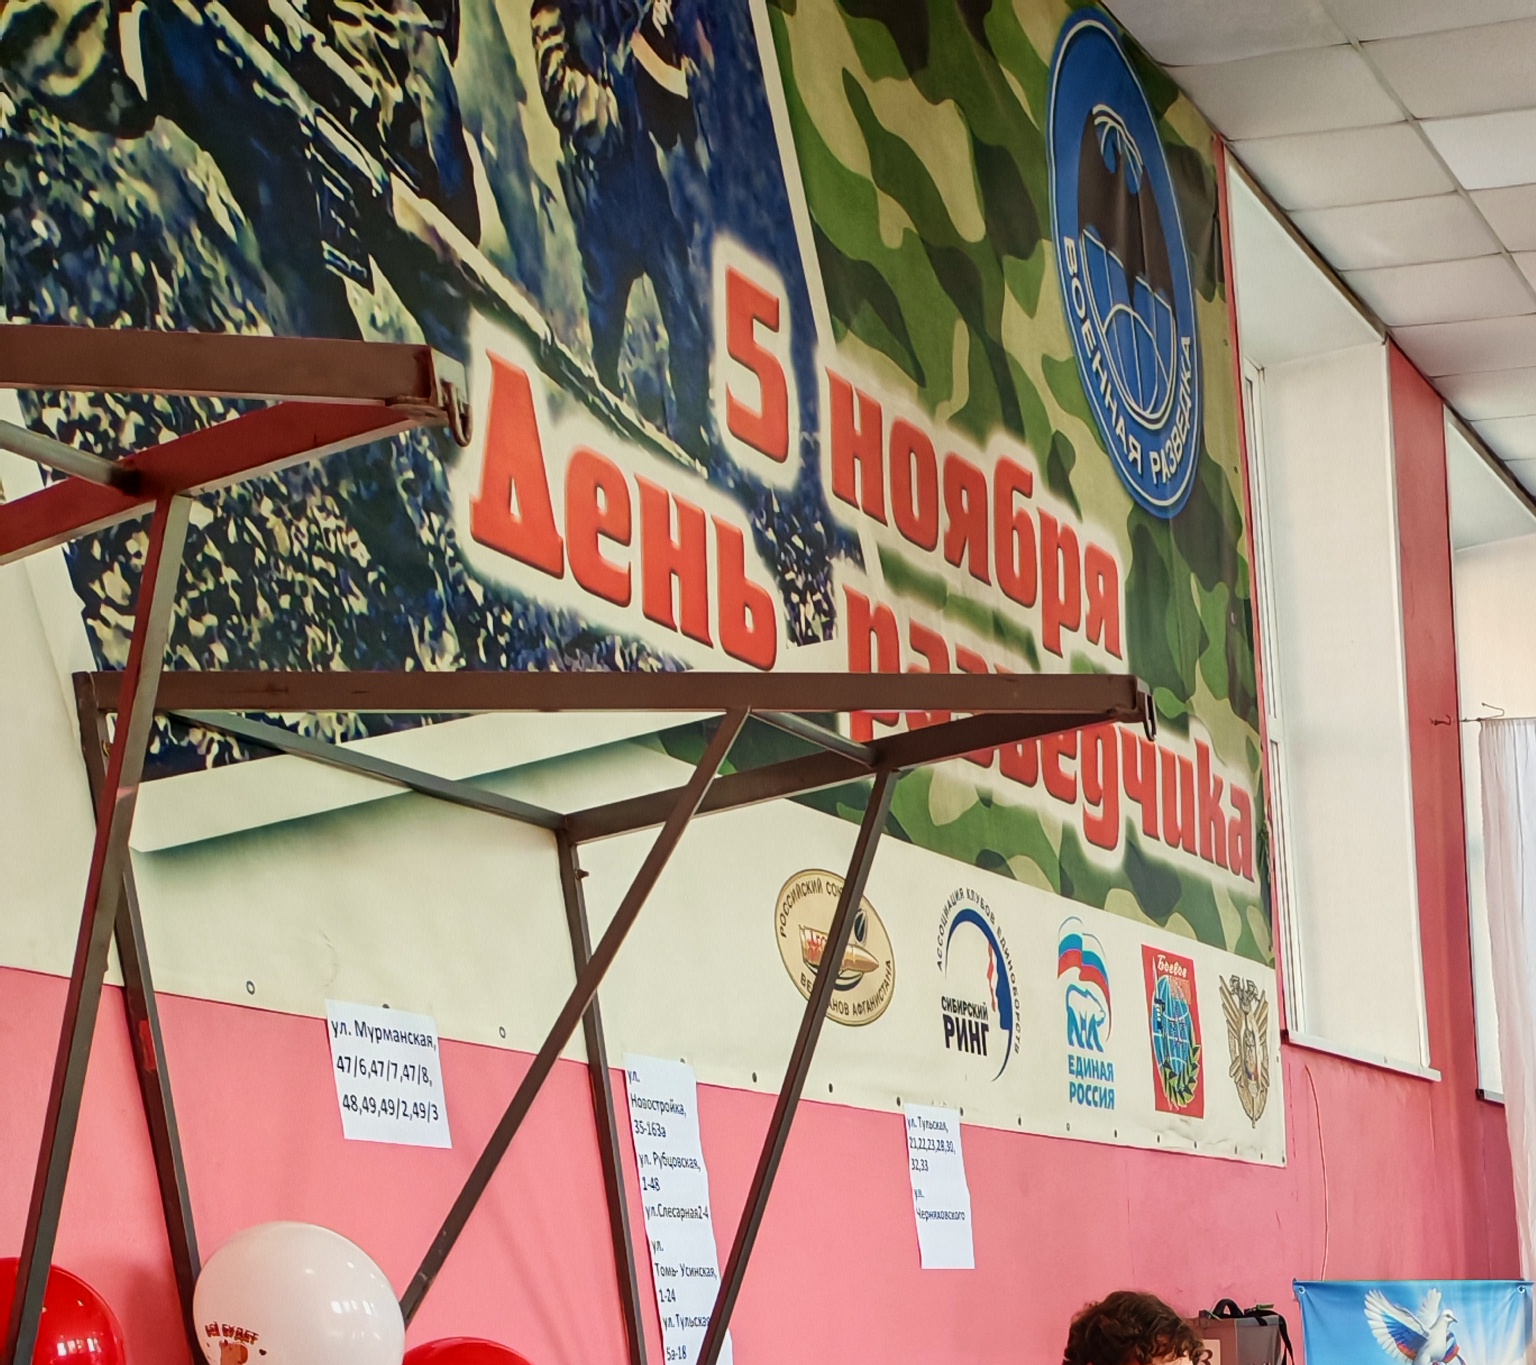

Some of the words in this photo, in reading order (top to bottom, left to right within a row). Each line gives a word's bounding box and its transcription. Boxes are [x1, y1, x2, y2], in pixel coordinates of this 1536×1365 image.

[1063, 236, 1143, 475] ВОЕННАЯ
[1150, 336, 1192, 485] РАЗВЕДКА
[725, 265, 789, 464] 5
[825, 366, 1123, 661] ноября
[469, 349, 776, 672] День
[779, 877, 823, 939] РОССИЙСКИЙ
[936, 887, 965, 973] АССОЦИАЦИЯ
[966, 887, 996, 926] КЛУБОВ
[996, 925, 1022, 1054] ЕДИНОБОРСТВ
[941, 995, 989, 1022] СИБИРСКИЙ
[330, 1020, 352, 1039] ул.
[354, 1019, 437, 1052] Мурманская,
[942, 1014, 990, 1057] РИНГ
[1067, 1054, 1115, 1083] ЕДИНАЯ
[1069, 1081, 1115, 1110] РОССИЯ
